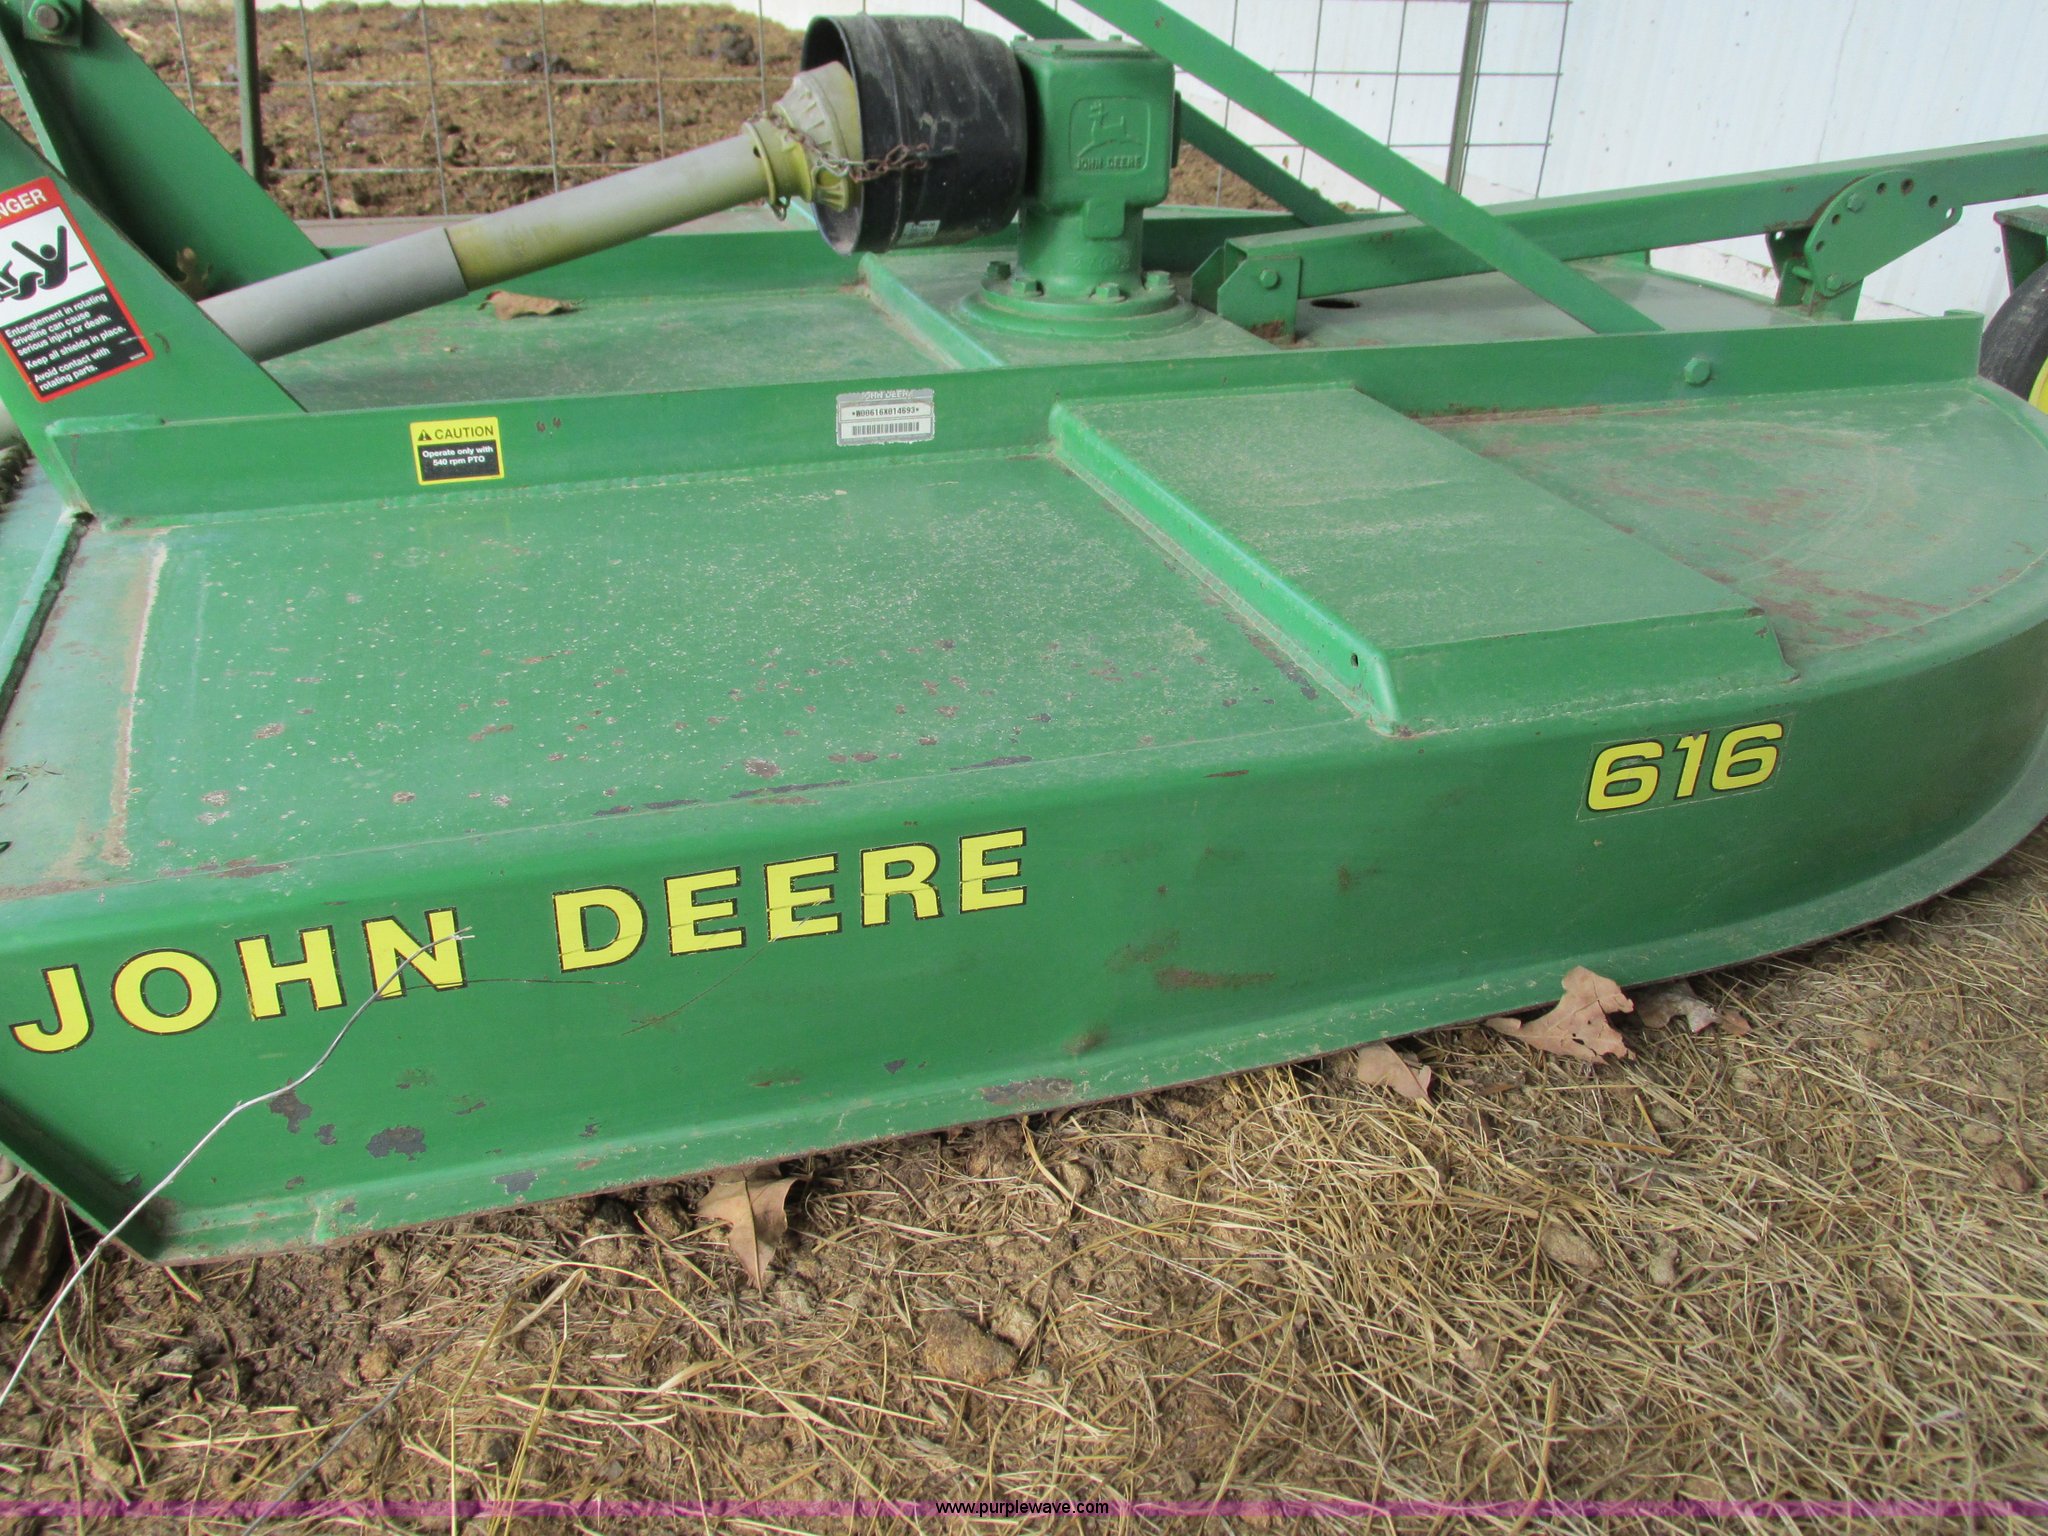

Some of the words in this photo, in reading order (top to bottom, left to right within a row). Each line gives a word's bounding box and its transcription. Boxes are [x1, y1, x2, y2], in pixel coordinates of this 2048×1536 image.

[4, 310, 64, 338] Entanglement
[63, 306, 73, 315] in
[73, 293, 108, 311] rotating
[11, 328, 47, 347] driveline
[48, 322, 64, 333] can
[65, 311, 91, 326] cause
[17, 339, 49, 356] serious
[48, 328, 73, 343] injury
[73, 325, 83, 333] or
[84, 314, 112, 330] death.
[24, 355, 49, 370] Keep
[48, 350, 60, 361] all
[60, 338, 91, 356] shields
[90, 335, 100, 344] in
[100, 325, 127, 342] place.
[34, 367, 59, 383] Avoid
[58, 354, 91, 373] contact
[90, 347, 111, 359] with
[39, 373, 74, 392] rotating
[72, 364, 98, 380] parts.
[434, 425, 494, 440] CAUTION
[422, 449, 456, 459] Operate
[457, 446, 474, 456] only
[476, 445, 494, 454] with
[433, 458, 448, 466] 540
[449, 457, 466, 466] rpm
[467, 455, 486, 464] PTO
[1586, 721, 1784, 812] 616
[8, 906, 468, 1055] JOHN
[552, 826, 1027, 974] DEERE
